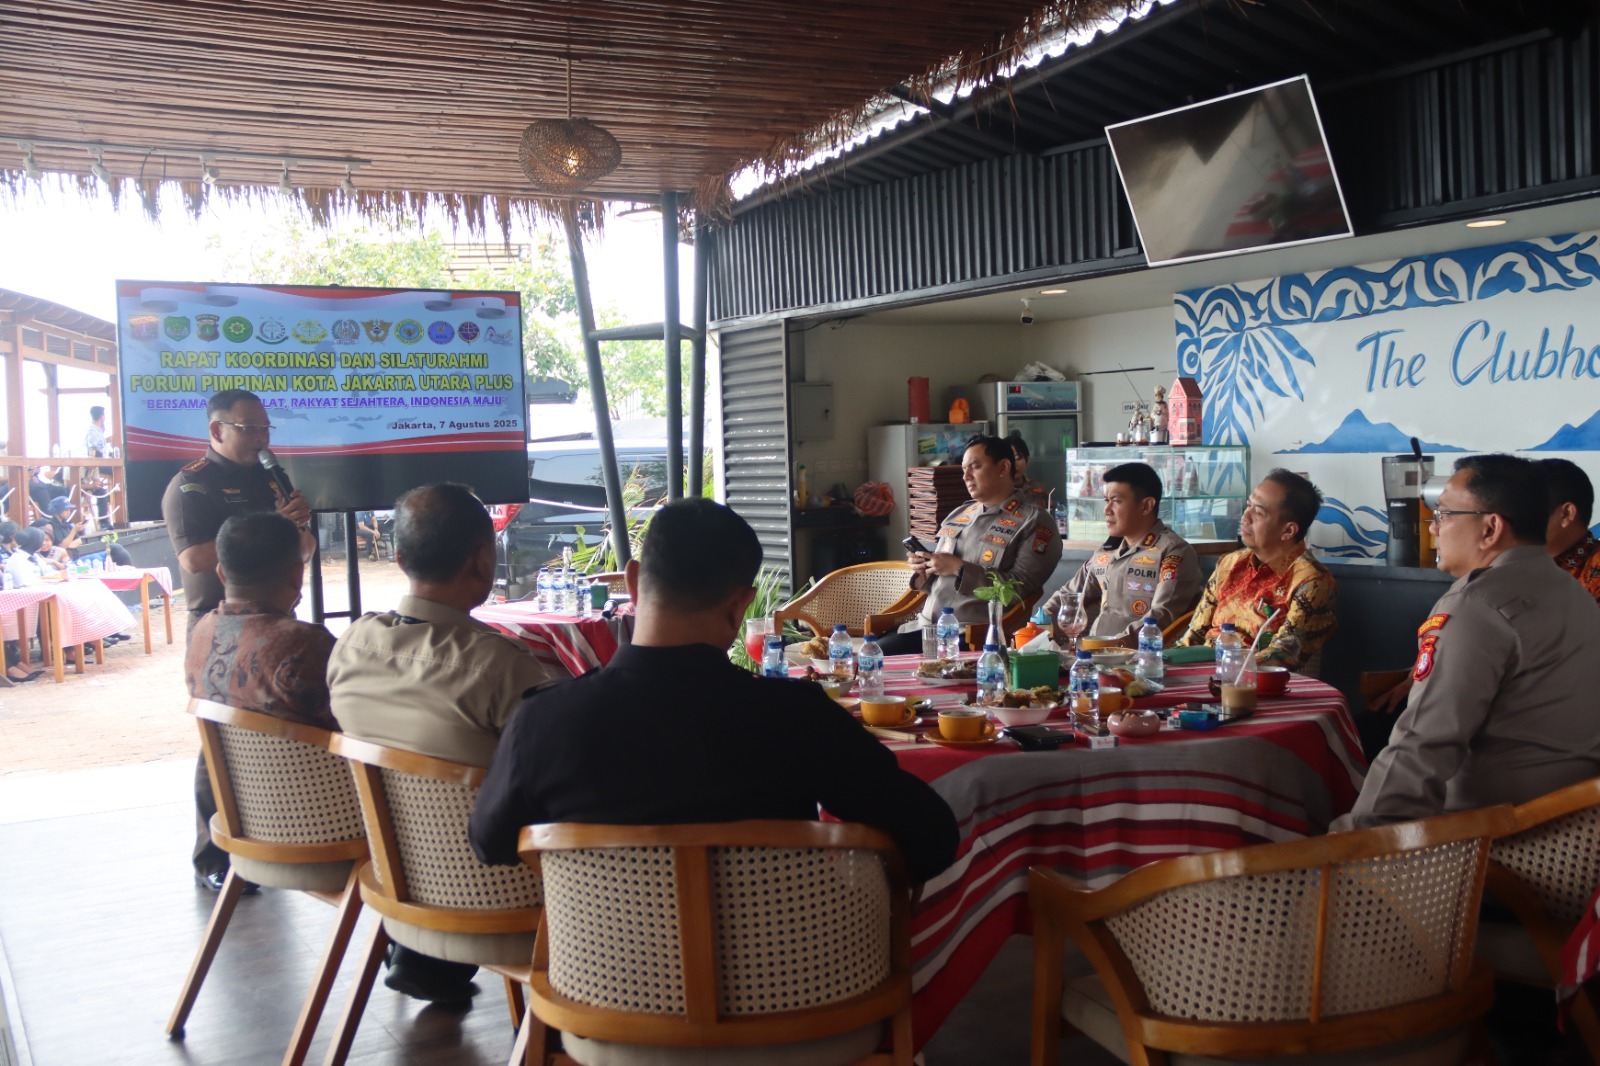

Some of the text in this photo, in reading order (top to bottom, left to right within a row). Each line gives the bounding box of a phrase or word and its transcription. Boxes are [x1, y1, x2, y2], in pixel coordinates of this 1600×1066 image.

[160, 351, 489, 369] RAPAT KOORDINASI DAN SILATURAHMI
[1356, 329, 1427, 393] The
[130, 373, 514, 392] FORUM PIMPINAN KOTA JAKARTA UTARA PLUS
[291, 397, 338, 408] RAKYAT
[340, 397, 408, 409] SEJAHTERA,
[410, 397, 471, 407] INDONESIA
[392, 419, 518, 431] Jakarta, 7 Agustus 2025
[990, 525, 1016, 536] POLRI
[1127, 567, 1157, 579] POLRI
